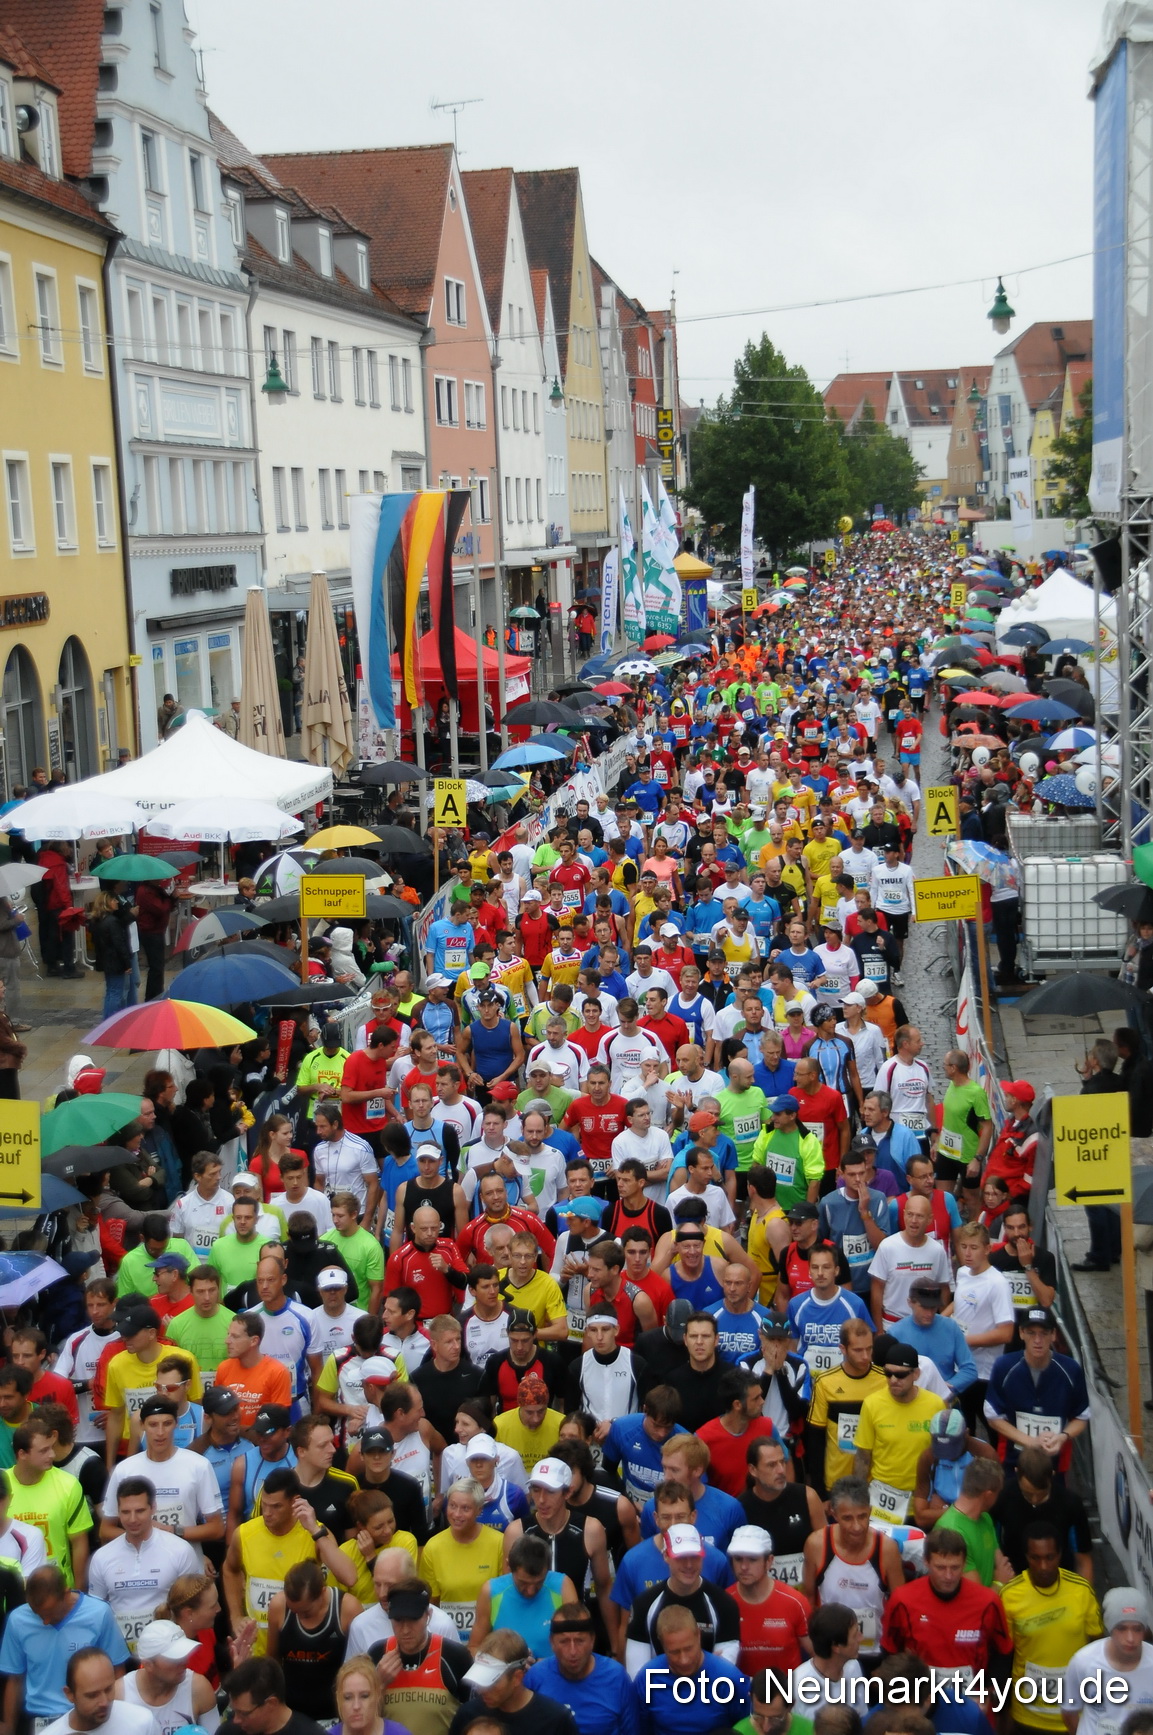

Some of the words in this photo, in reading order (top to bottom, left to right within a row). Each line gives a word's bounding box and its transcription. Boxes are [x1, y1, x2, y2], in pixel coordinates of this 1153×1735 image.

[657, 409, 673, 493] HOTEL
[746, 595, 754, 606] B
[955, 591, 963, 602] B
[438, 780, 463, 790] Block
[928, 788, 954, 799] Block
[441, 793, 460, 817] A
[933, 801, 952, 825] A
[90, 829, 109, 837] Audi
[880, 877, 903, 885] THULE
[305, 886, 360, 897] Schnupper-
[917, 888, 975, 900] Schnupper-
[324, 898, 342, 907] lauf
[937, 900, 956, 910] lauf
[451, 954, 461, 963] 37
[737, 1119, 760, 1134] 3047
[1057, 1122, 1127, 1143] Jugend-
[0, 1149, 22, 1165] auf
[1076, 1146, 1109, 1162] lauf
[571, 1315, 586, 1330] 50
[805, 1322, 842, 1333] Fitness
[718, 1331, 755, 1343] Fitness
[815, 1355, 831, 1369] 90
[878, 1493, 896, 1511] 99
[124, 1619, 153, 1641] 26
[954, 1629, 981, 1638] JURA
[384, 1692, 447, 1705] DEUTSCHLAND
